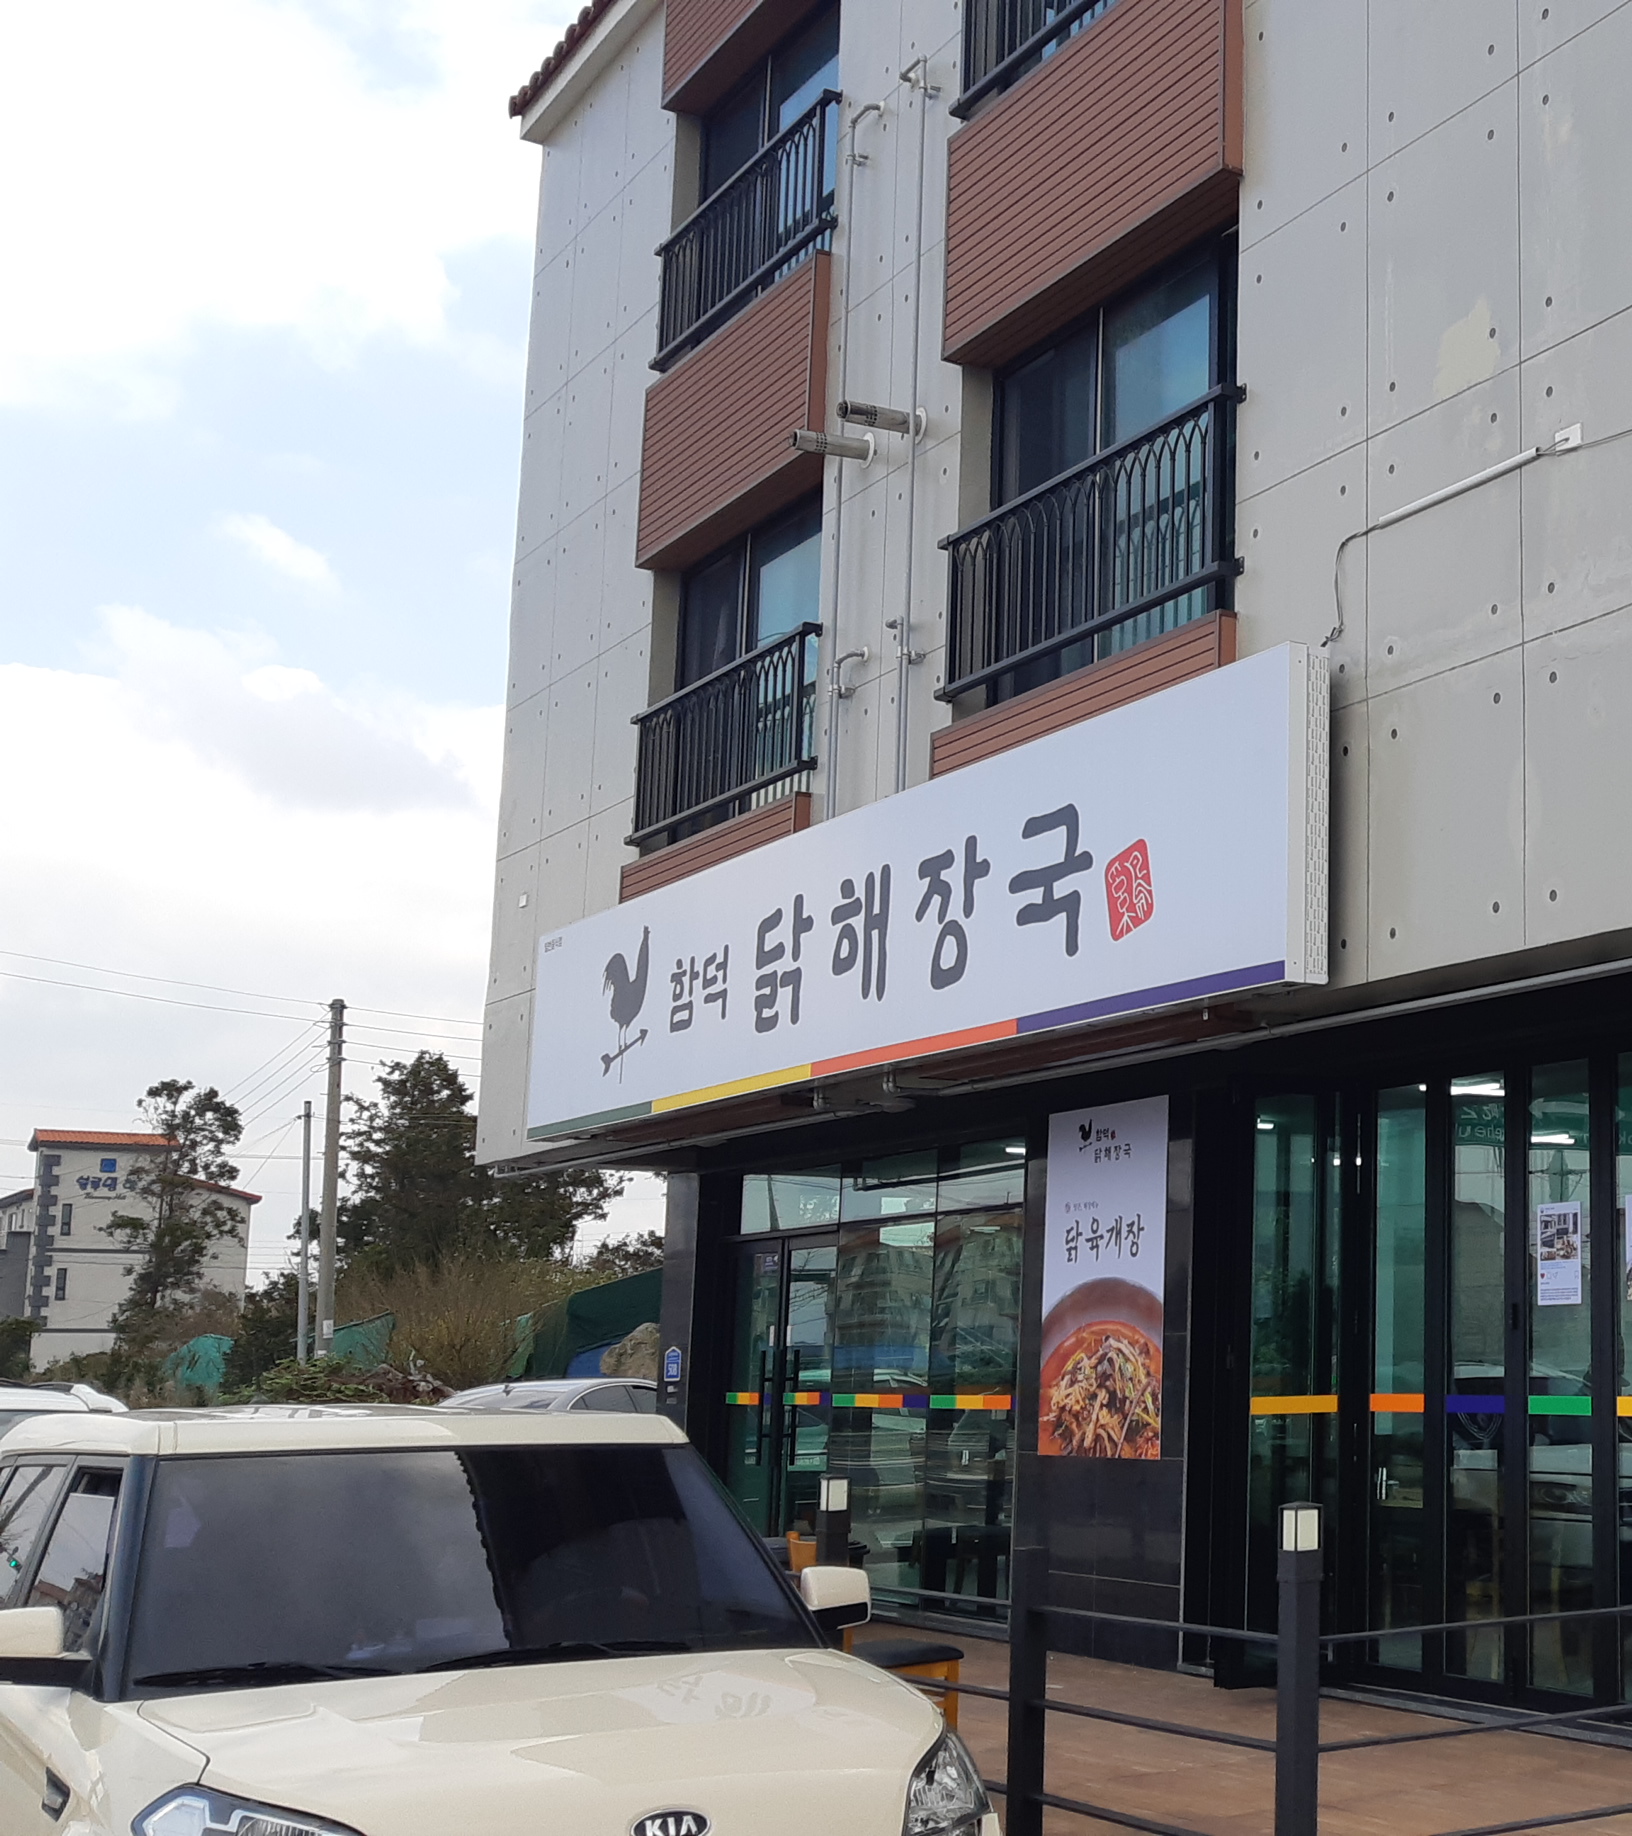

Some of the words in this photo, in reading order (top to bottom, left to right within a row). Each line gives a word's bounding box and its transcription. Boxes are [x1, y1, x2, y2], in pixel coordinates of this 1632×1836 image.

[669, 944, 730, 1035] 함덕
[755, 803, 1094, 1035] 닭해장국
[1095, 1127, 1110, 1142] 함덕
[1065, 1214, 1146, 1264] 닭육개장
[644, 1815, 698, 1836] KIA
